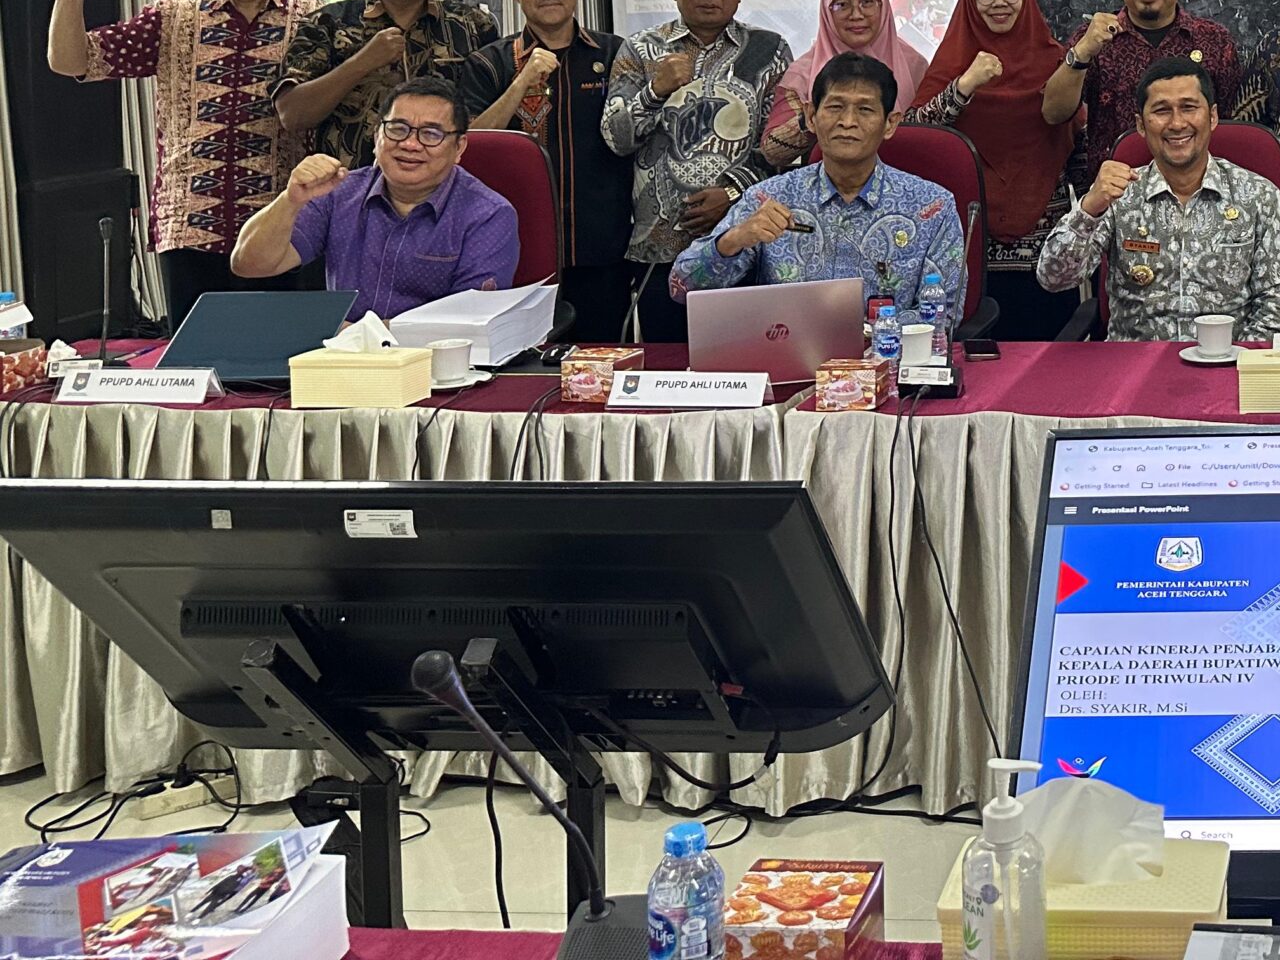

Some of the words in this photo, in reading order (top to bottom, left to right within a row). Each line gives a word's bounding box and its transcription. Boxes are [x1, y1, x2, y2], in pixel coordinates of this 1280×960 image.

[769, 323, 788, 341] hp
[99, 377, 133, 386] PPUPD
[135, 378, 159, 386] AHLI
[160, 378, 195, 386] UTAMA
[655, 380, 688, 389] PPUPD
[690, 381, 712, 389] AHLI
[714, 381, 748, 389] UTAMA
[1074, 482, 1101, 490] Getting
[1157, 480, 1179, 488] Latest
[1181, 480, 1218, 488] Headlines
[1242, 480, 1269, 488] Getting
[1092, 506, 1137, 514] Presentasi
[1138, 504, 1190, 514] PowerPoint
[1116, 580, 1186, 589] PEMERINTAH
[1187, 579, 1250, 588] KABUPATEN
[1137, 590, 1167, 598] ACEH
[1168, 589, 1228, 598] TENGGARA
[1059, 645, 1133, 656] CAPAIAN
[1137, 644, 1208, 656] KINERJA
[1057, 659, 1123, 671] KEPALA
[1128, 658, 1201, 670] DAERAH
[1056, 674, 1120, 685] PRIODE
[1124, 674, 1137, 684] II
[1140, 673, 1231, 685] TRIWULAN
[1236, 673, 1255, 684] IV
[1060, 690, 1107, 701] OLEH:
[1059, 704, 1085, 714] Drs.
[1090, 703, 1152, 715] SYAKIR,
[1156, 702, 1188, 713] M.Si
[1201, 831, 1233, 839] Search
